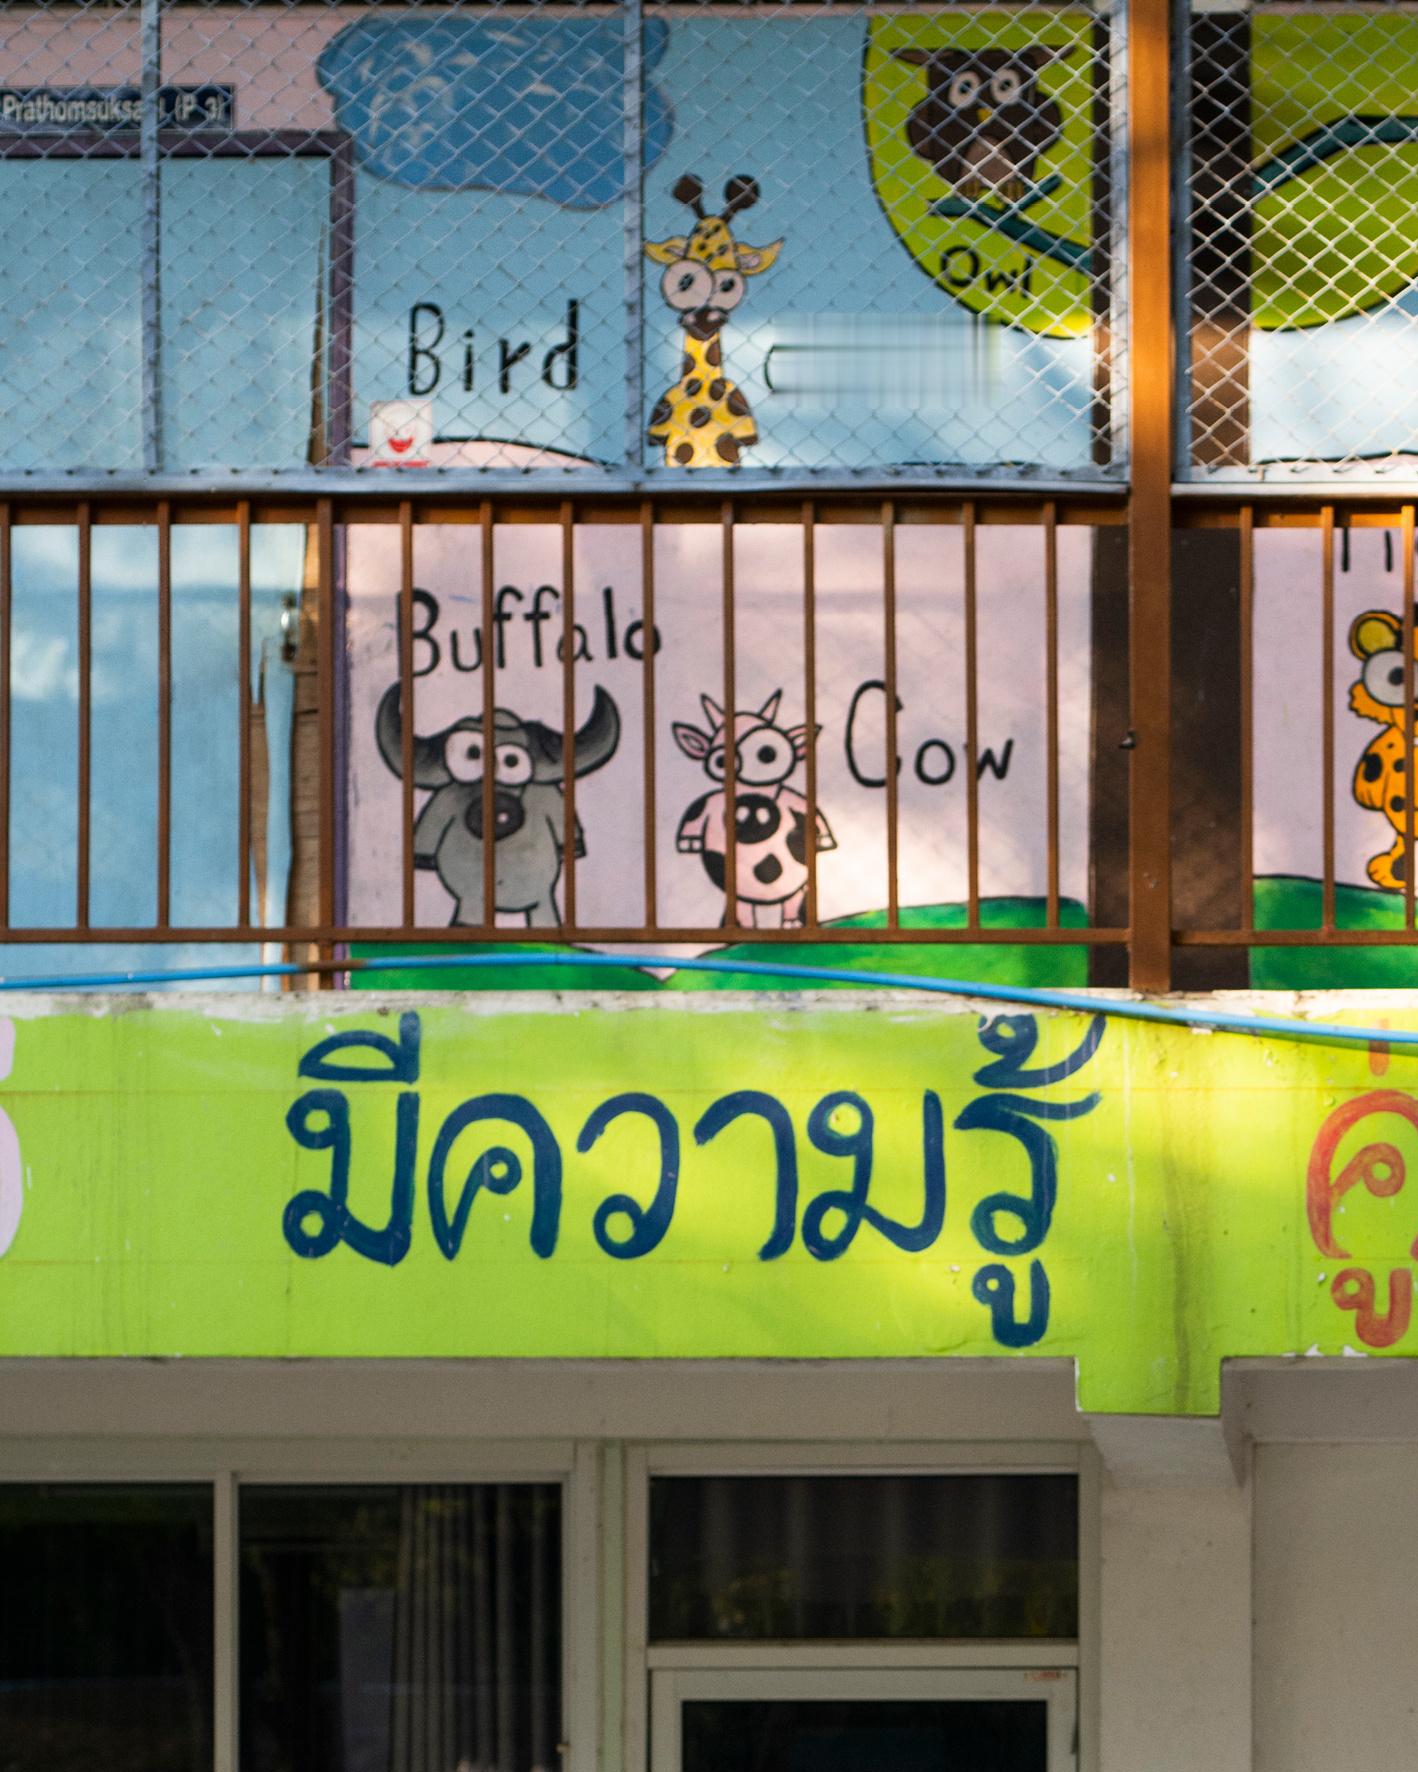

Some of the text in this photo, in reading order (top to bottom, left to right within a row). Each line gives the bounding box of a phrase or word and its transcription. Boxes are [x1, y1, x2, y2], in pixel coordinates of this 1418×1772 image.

[939, 244, 1033, 298] Owl
[408, 299, 579, 396] Bird
[396, 584, 662, 678] Buffalo
[844, 679, 1014, 789] Cow
[283, 1010, 1107, 1348] มีความรู้
